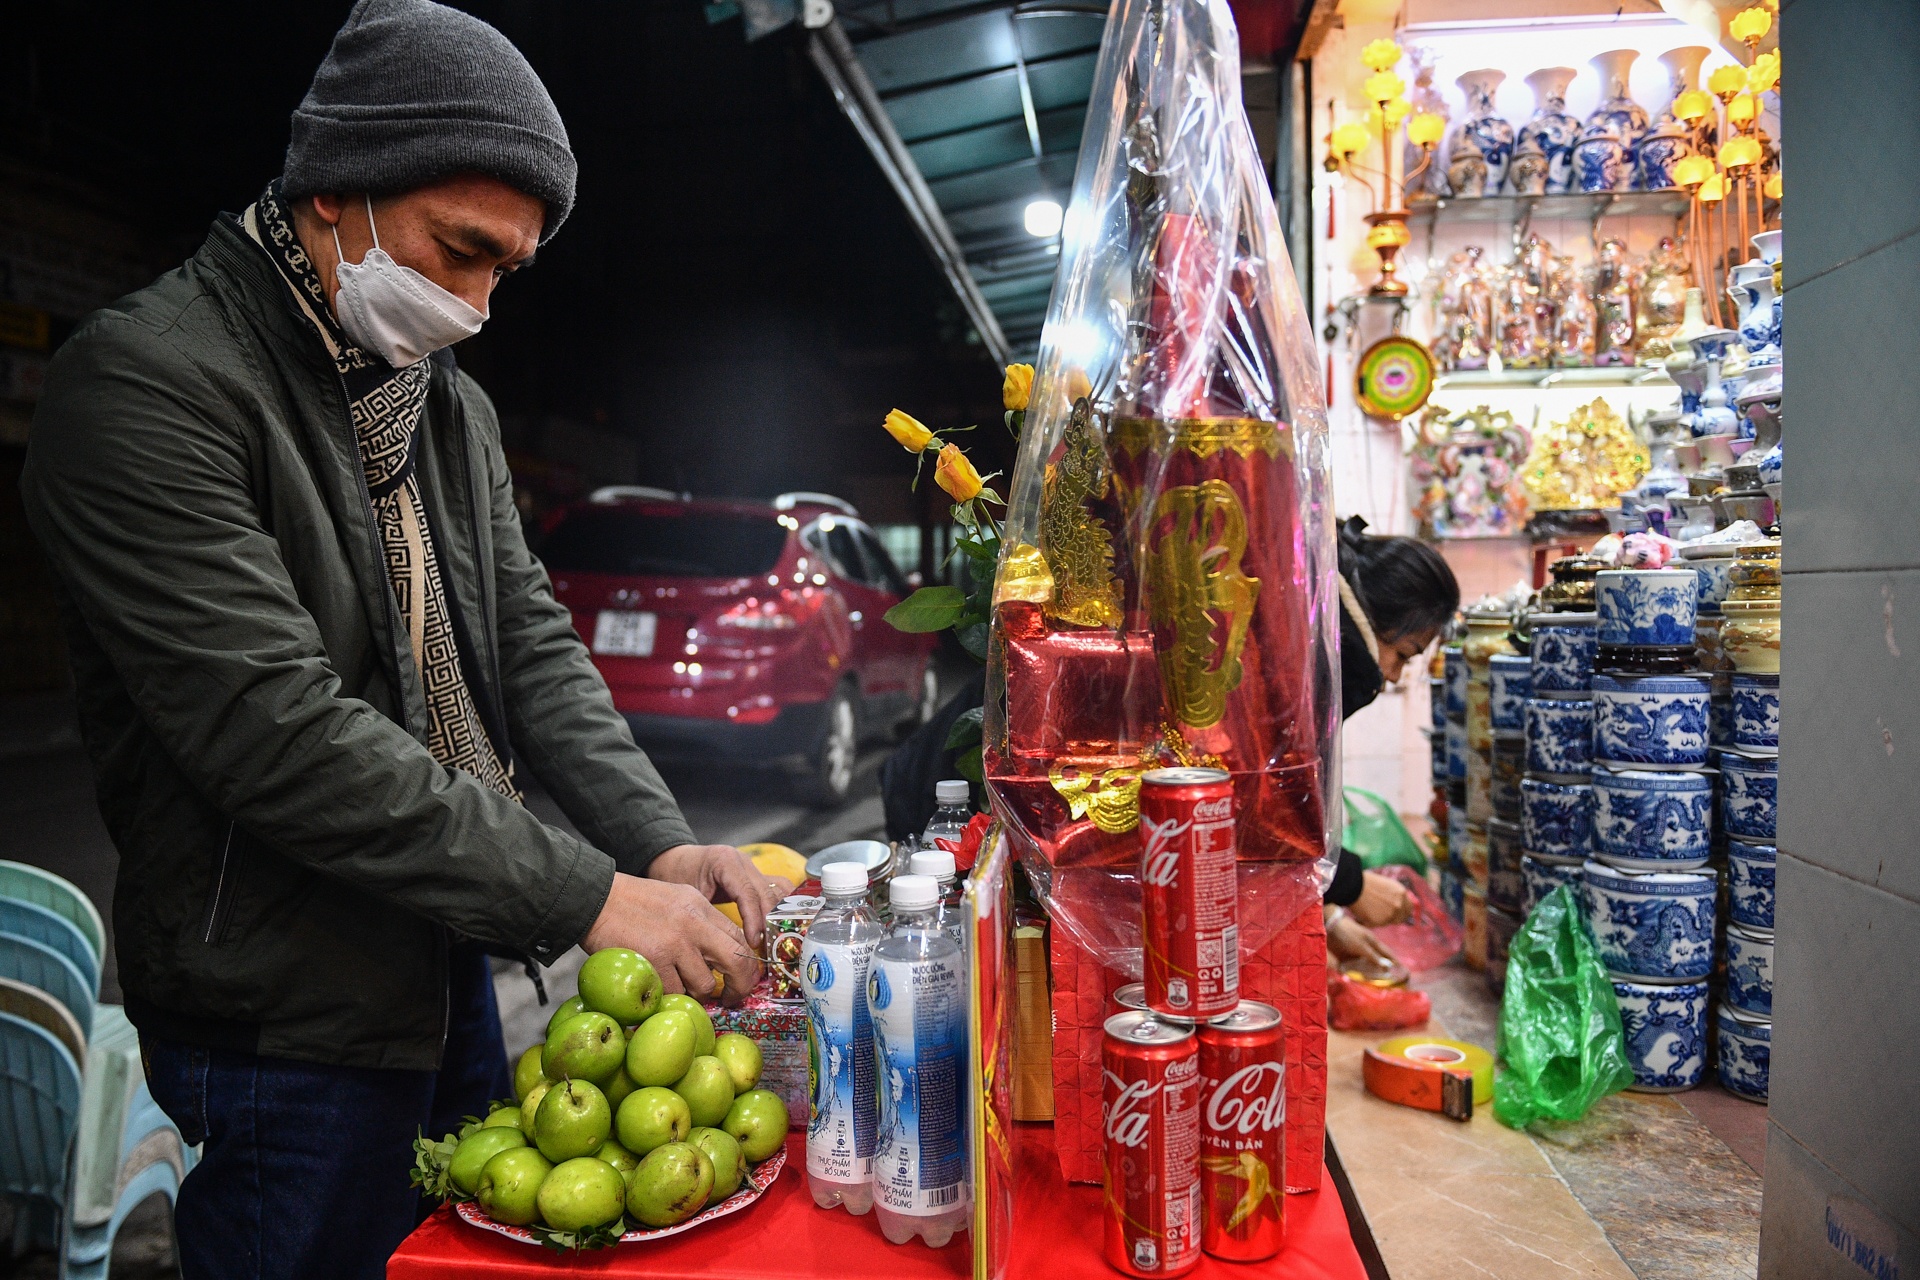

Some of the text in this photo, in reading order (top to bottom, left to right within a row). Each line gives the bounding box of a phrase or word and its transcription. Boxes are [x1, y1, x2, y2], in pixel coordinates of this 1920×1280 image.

[1235, 1137, 1263, 1150] BẢN
[833, 1168, 850, 1178] SUNG
[893, 1199, 912, 1209] SUNG
